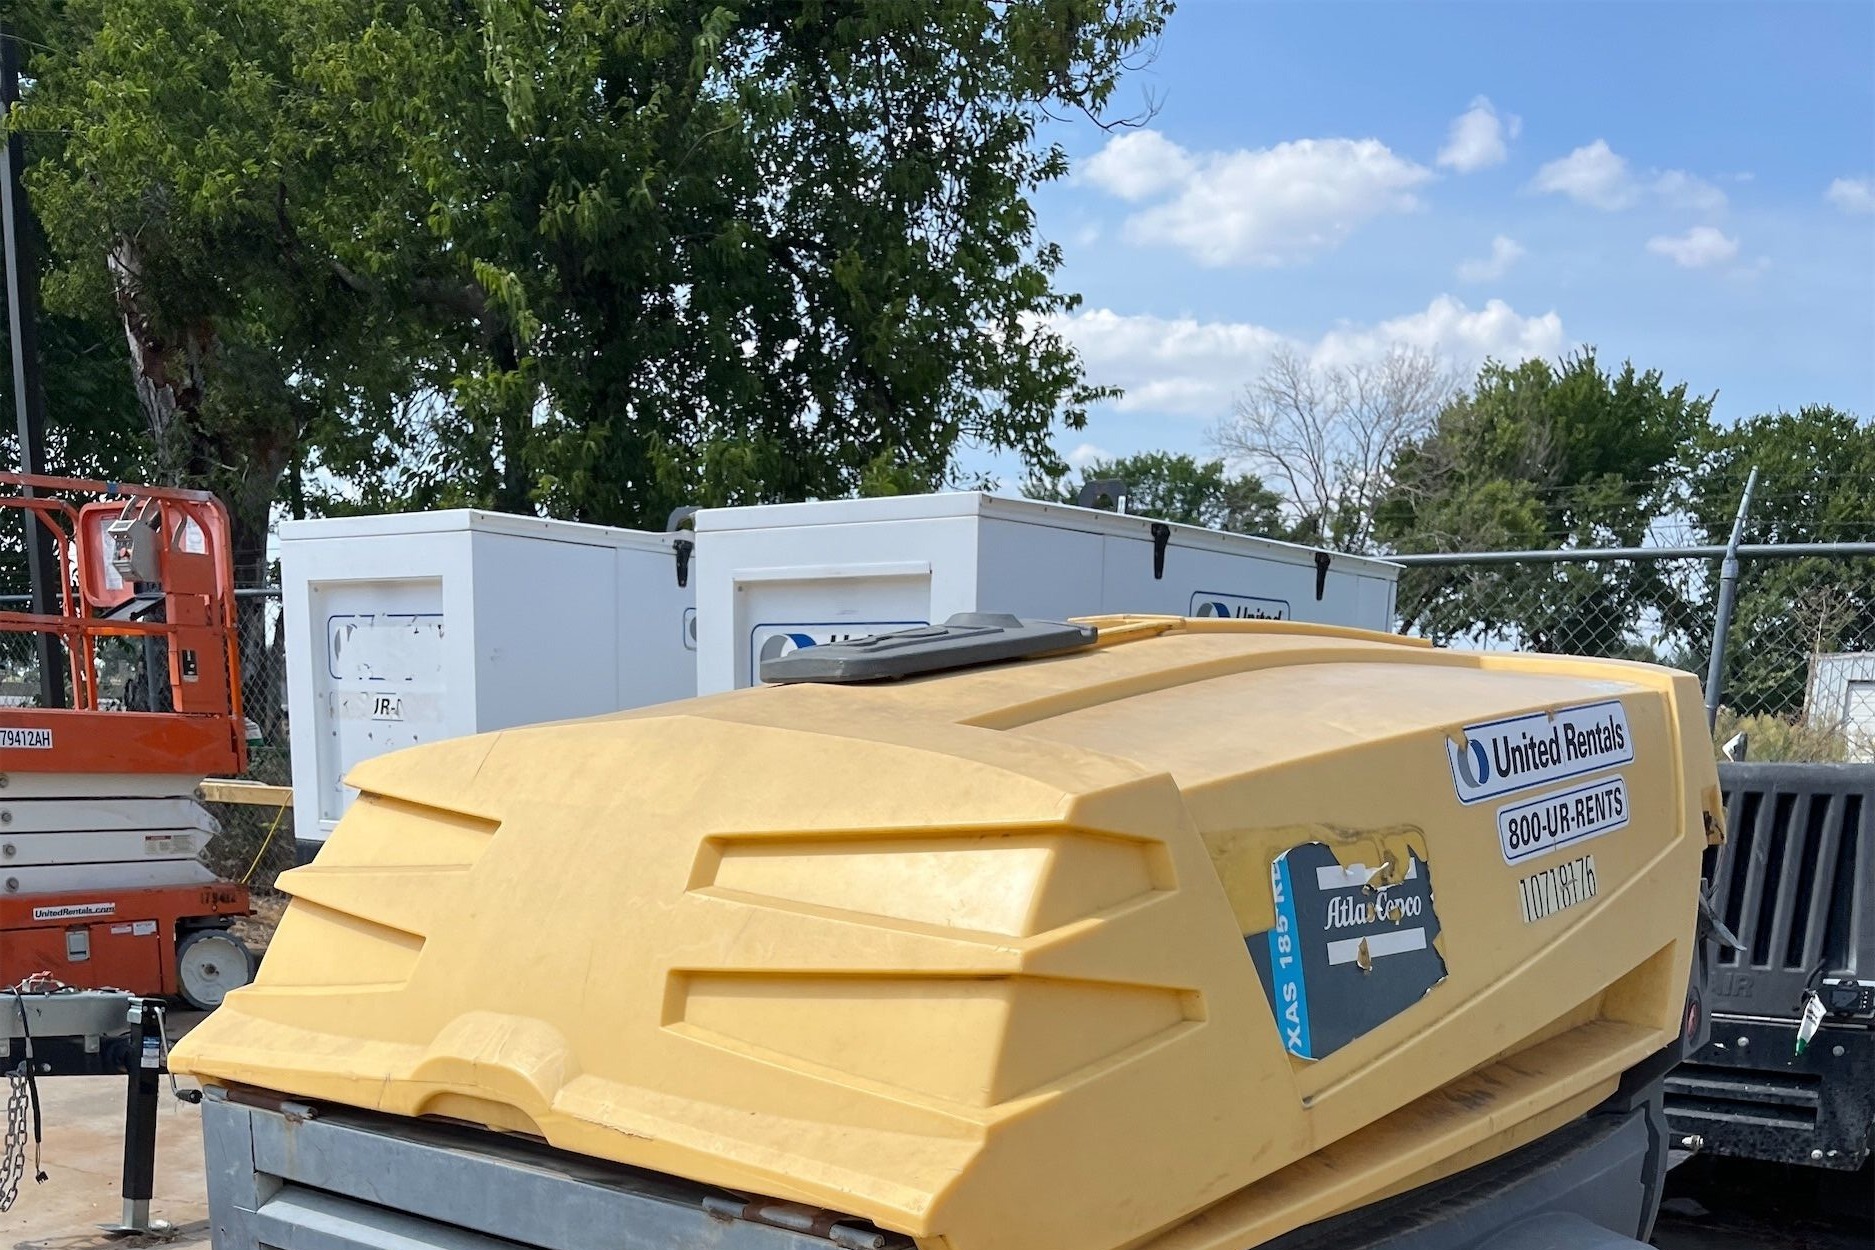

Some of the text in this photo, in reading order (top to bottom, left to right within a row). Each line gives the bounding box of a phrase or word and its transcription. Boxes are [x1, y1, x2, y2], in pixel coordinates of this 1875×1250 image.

[0, 730, 51, 747] 79412AH
[1492, 714, 1625, 778] United Rentals
[1508, 787, 1624, 850] 800-UR-RENTS
[1519, 854, 1597, 923] 10718176
[1276, 915, 1293, 969] 185
[1283, 981, 1303, 1048] XAS
